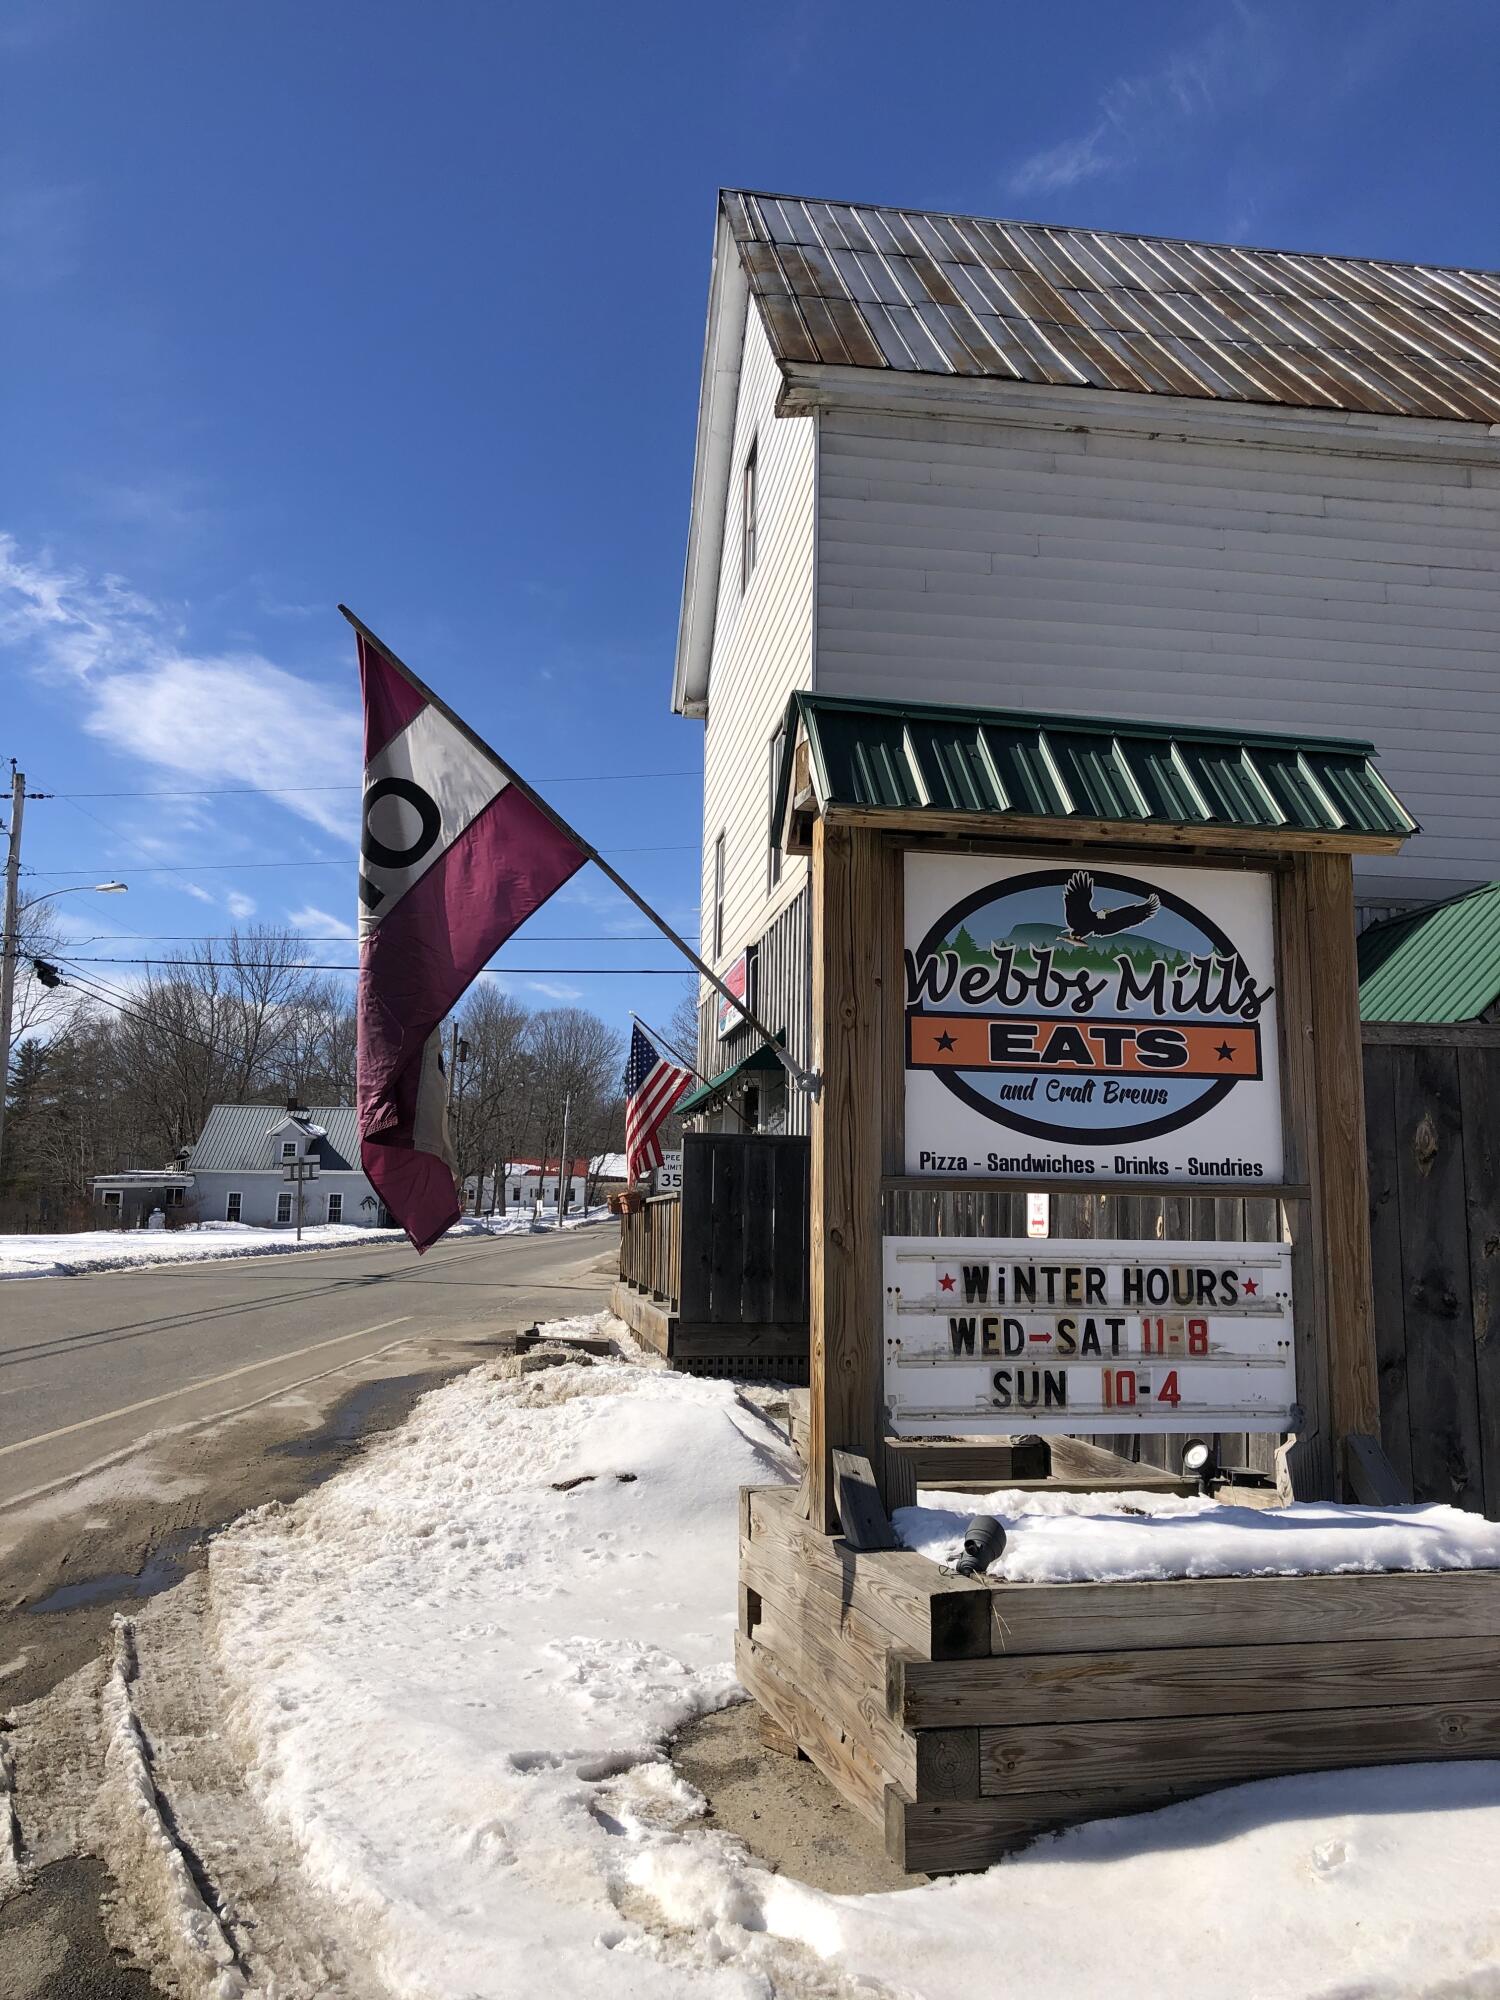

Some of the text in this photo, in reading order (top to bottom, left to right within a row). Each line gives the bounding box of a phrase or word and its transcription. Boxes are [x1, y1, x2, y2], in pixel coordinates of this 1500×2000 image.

[904, 944, 1275, 1020] Webbs Mills
[989, 1023, 1188, 1067] EATS
[1000, 1077, 1169, 1105] and Craft Brews
[661, 1173, 682, 1187] 35
[919, 1151, 968, 1171] Pizza
[987, 1152, 1095, 1174] Sandwiches
[1114, 1155, 1169, 1176] Drinks
[1188, 1157, 1264, 1177] Sundries
[963, 1265, 1239, 1306] WiNTER HOURS
[949, 1317, 1025, 1357] WED
[1055, 1317, 1126, 1357] SAT
[992, 1370, 1182, 1409] SUN 10-4
